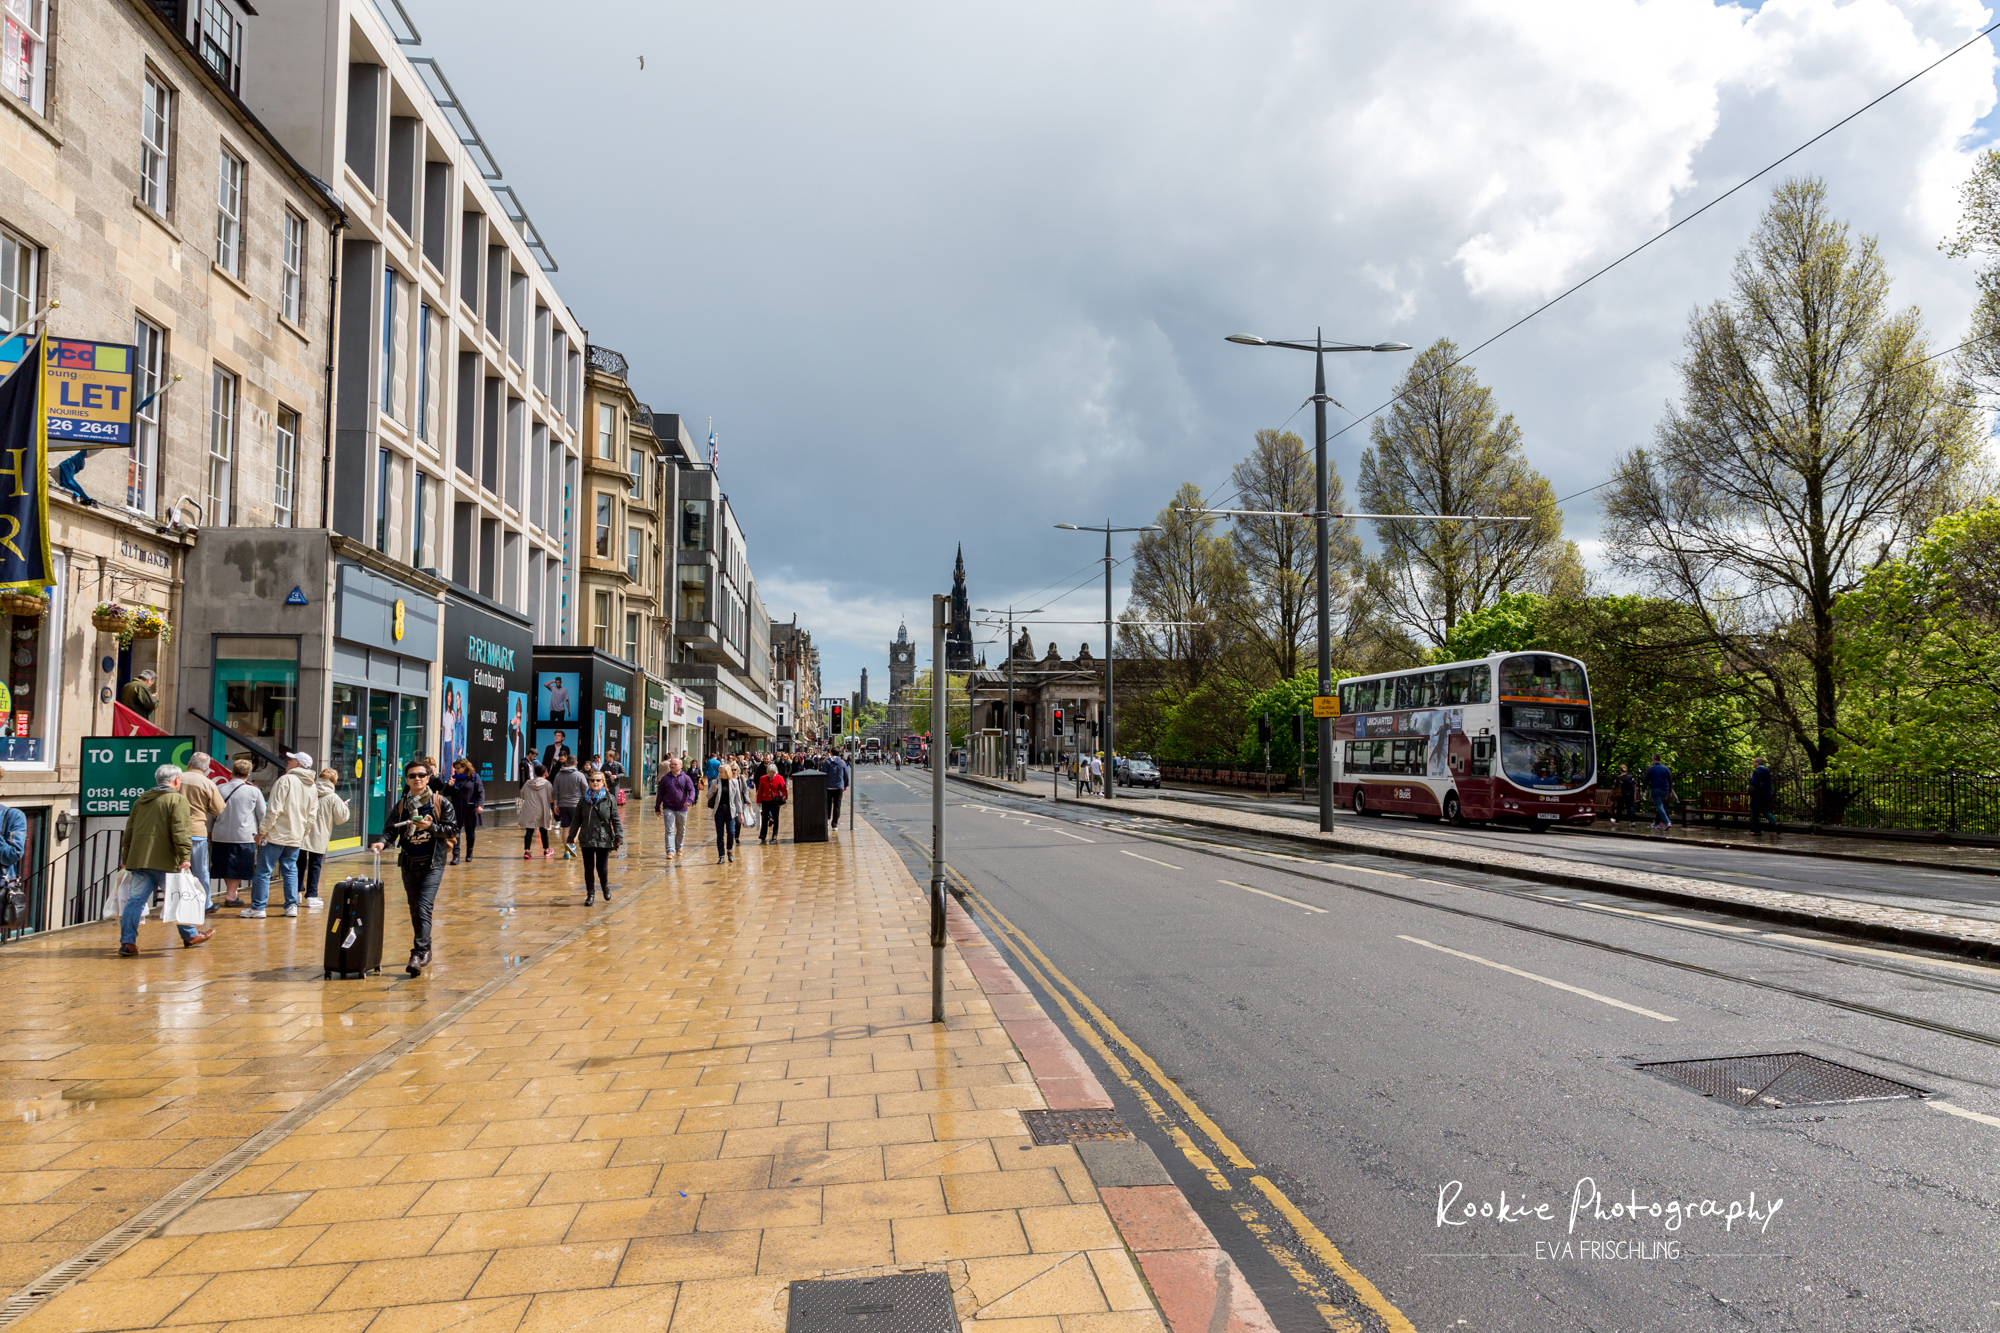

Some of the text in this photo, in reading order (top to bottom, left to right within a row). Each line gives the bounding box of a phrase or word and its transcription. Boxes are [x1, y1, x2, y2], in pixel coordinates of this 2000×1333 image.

[60, 381, 127, 411] LET
[79, 421, 119, 435] 2641
[468, 635, 515, 672] PRIMARK
[474, 668, 505, 693] Edinburgh
[1366, 716, 1394, 727] UNCHARTED
[1516, 720, 1552, 730] East Craigs
[1563, 715, 1574, 726] 31
[88, 749, 162, 764] TO LET
[87, 787, 145, 798] 0131 469
[86, 800, 130, 812] CBRE
